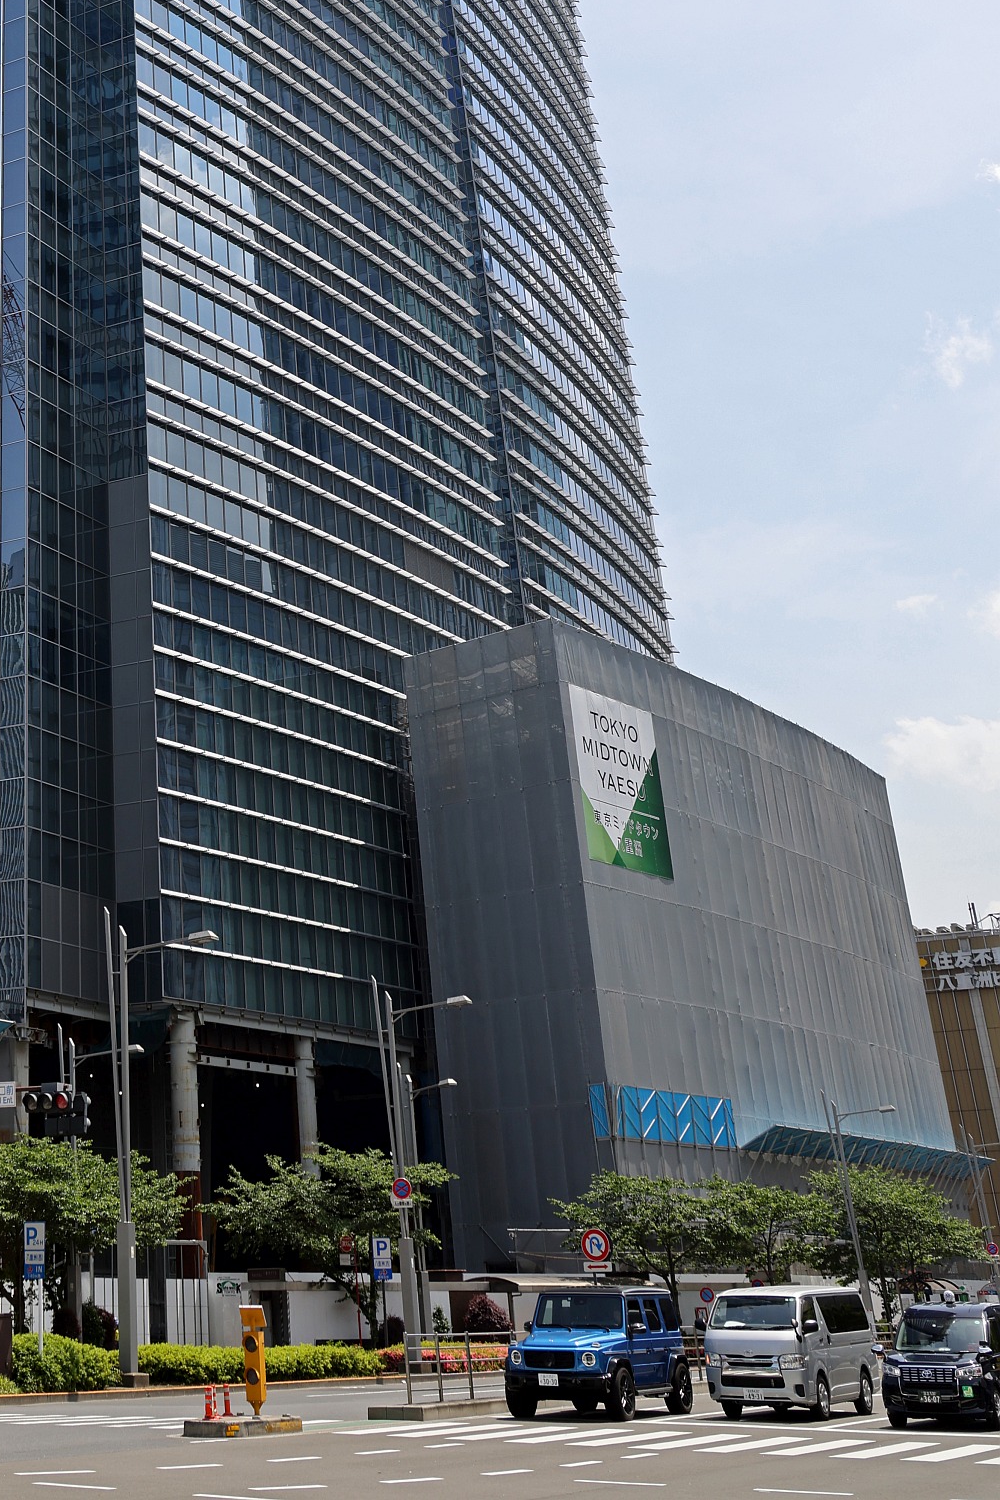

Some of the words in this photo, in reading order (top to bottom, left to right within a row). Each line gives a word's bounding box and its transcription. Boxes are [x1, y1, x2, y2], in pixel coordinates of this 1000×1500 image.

[590, 711, 638, 743] TOKYO
[582, 736, 654, 777] MIDTOWN
[597, 769, 646, 801] YAESU
[594, 809, 659, 840] 東京ミッドタウン
[26, 1227, 38, 1246] P
[376, 1240, 388, 1256] P
